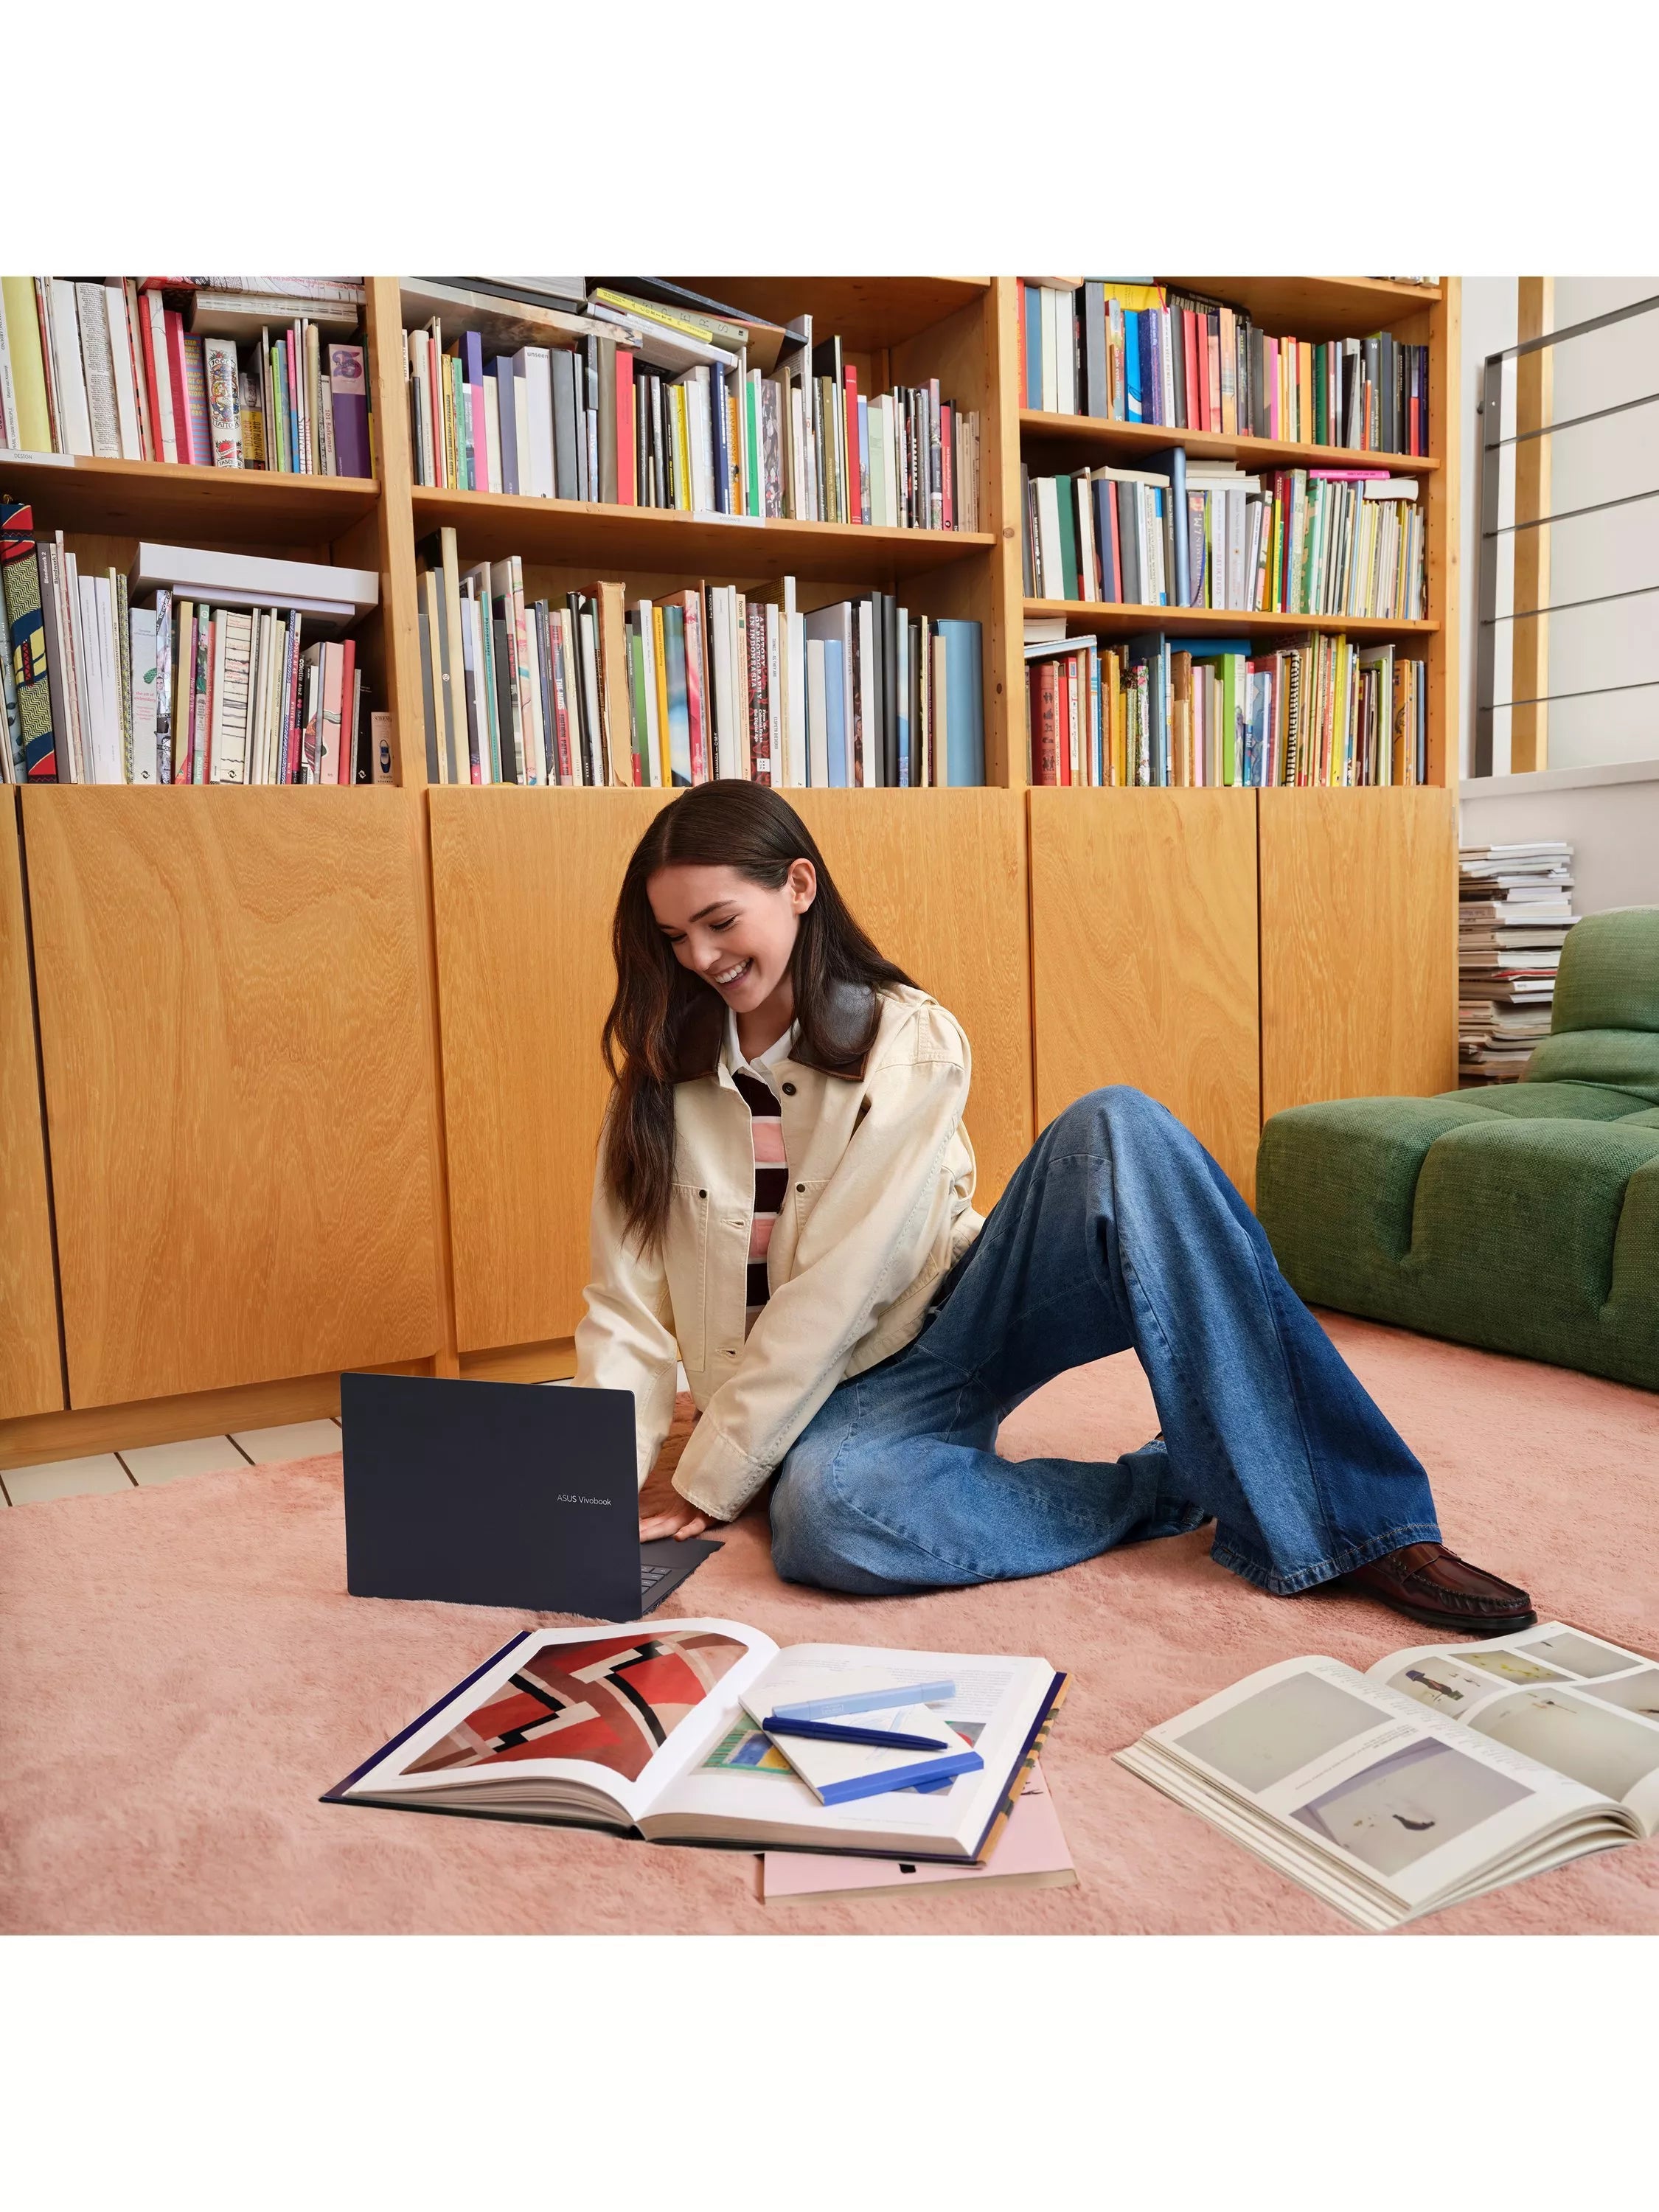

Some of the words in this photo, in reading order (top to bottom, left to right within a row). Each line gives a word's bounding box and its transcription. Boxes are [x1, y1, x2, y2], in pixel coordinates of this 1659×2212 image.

[215, 420, 240, 428] TATTOS
[749, 616, 755, 626] IN
[755, 616, 759, 628] OF
[557, 692, 565, 710] NAZIS
[557, 1494, 577, 1503] ASUS
[578, 1495, 612, 1506] Vivobook
